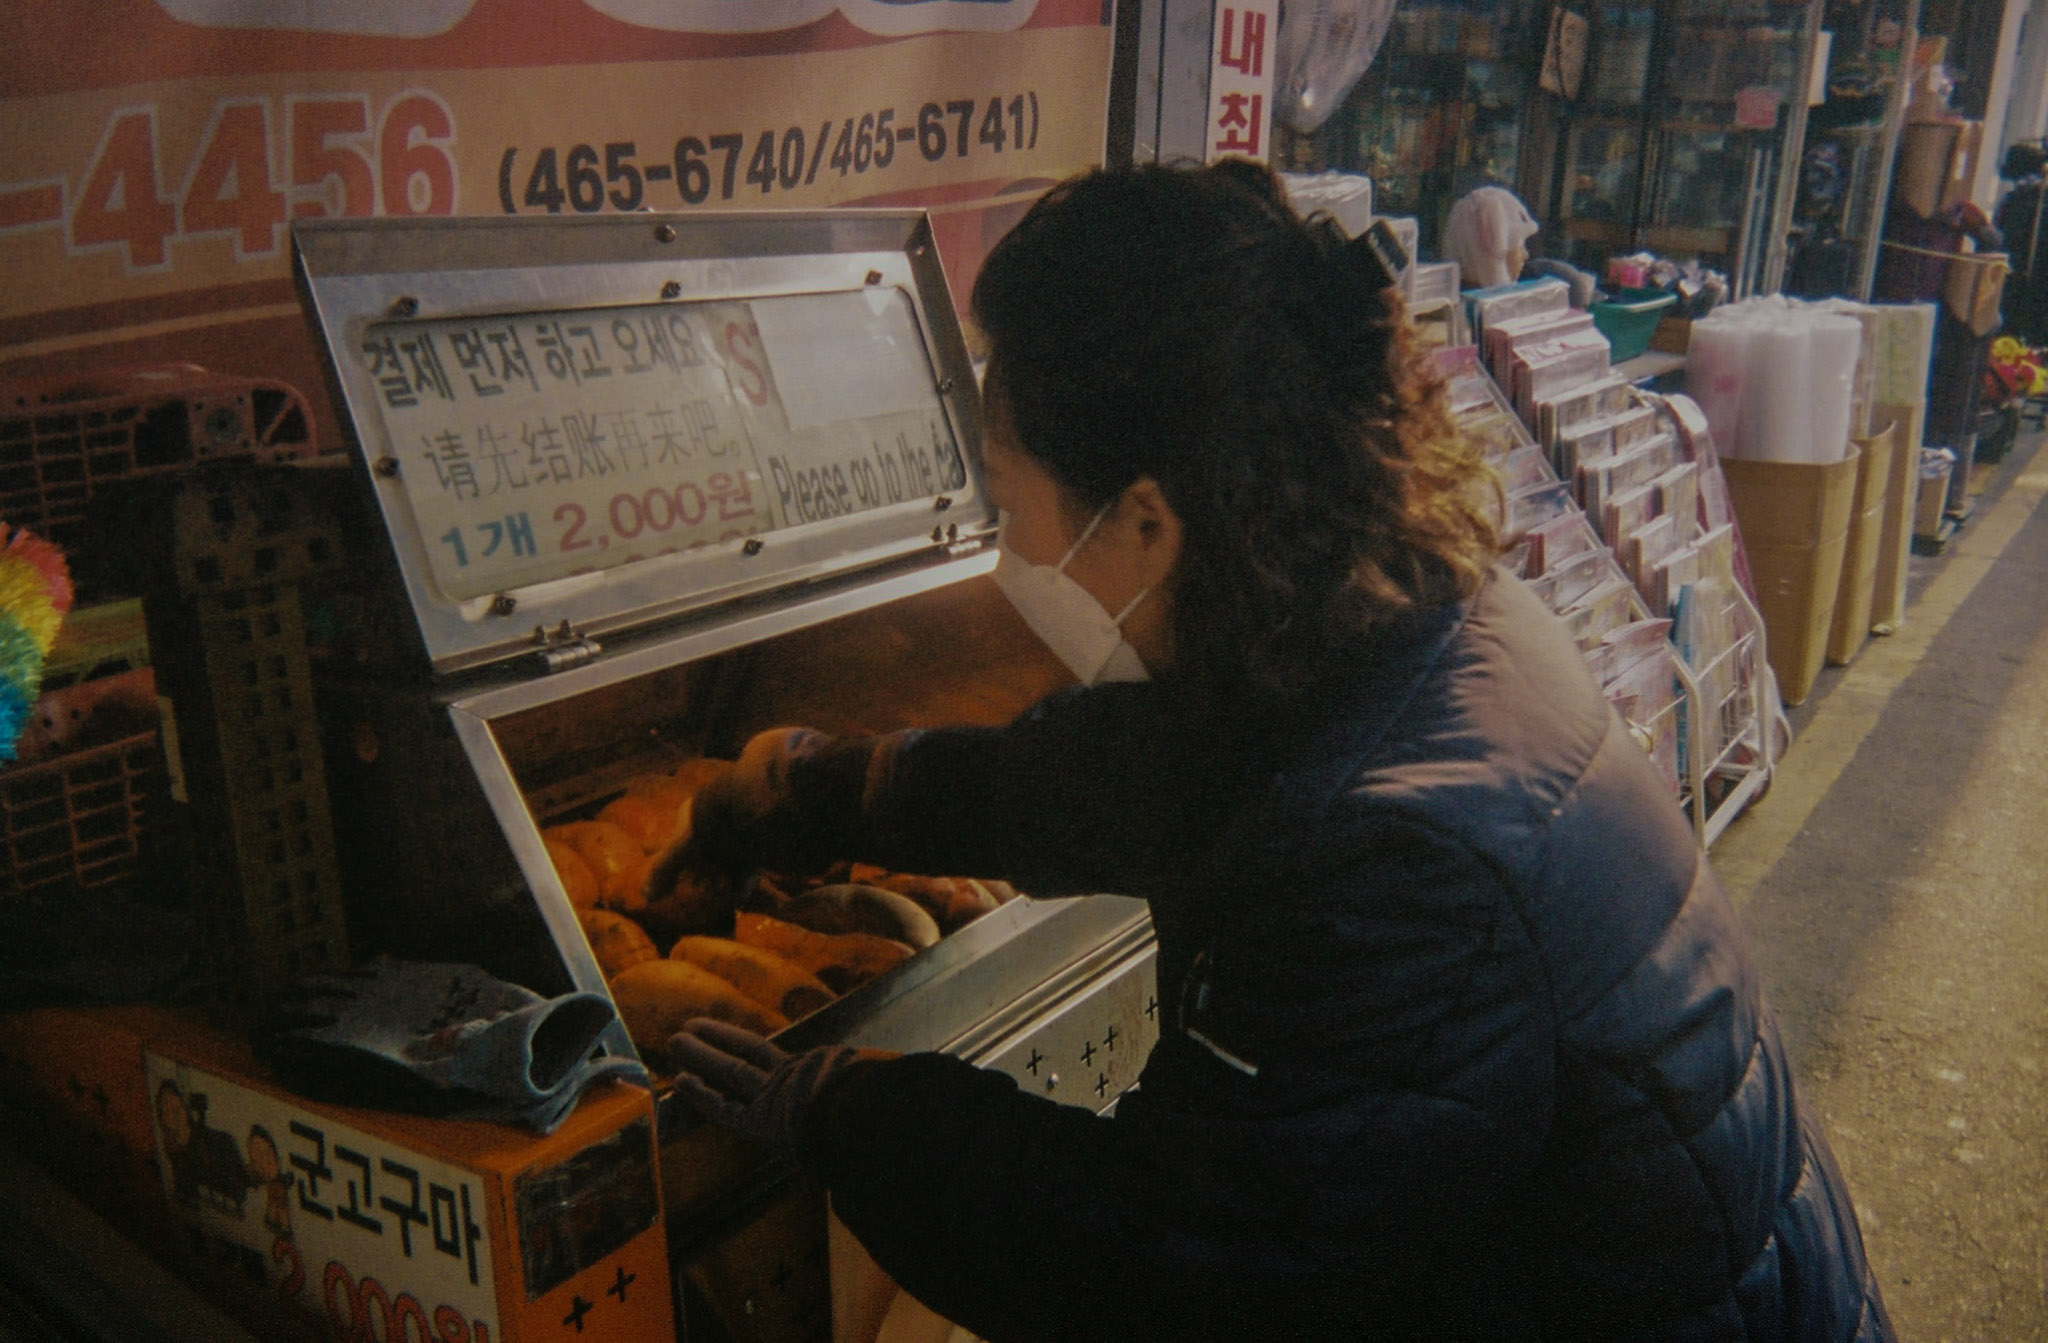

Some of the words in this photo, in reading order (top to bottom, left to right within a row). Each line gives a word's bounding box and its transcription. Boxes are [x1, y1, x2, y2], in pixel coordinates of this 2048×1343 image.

[500, 91, 1039, 213] (465-6740/465-6741)
[362, 331, 454, 408] 결제
[448, 324, 540, 397] 먼저
[536, 321, 612, 386] 하고
[611, 314, 708, 376] 오세요
[441, 511, 537, 567] 1개
[553, 469, 755, 552] 2,000원
[768, 454, 852, 526] Please
[850, 456, 880, 508] go
[873, 441, 902, 503] to
[896, 432, 934, 498] the
[289, 1120, 480, 1286] 군고구마
